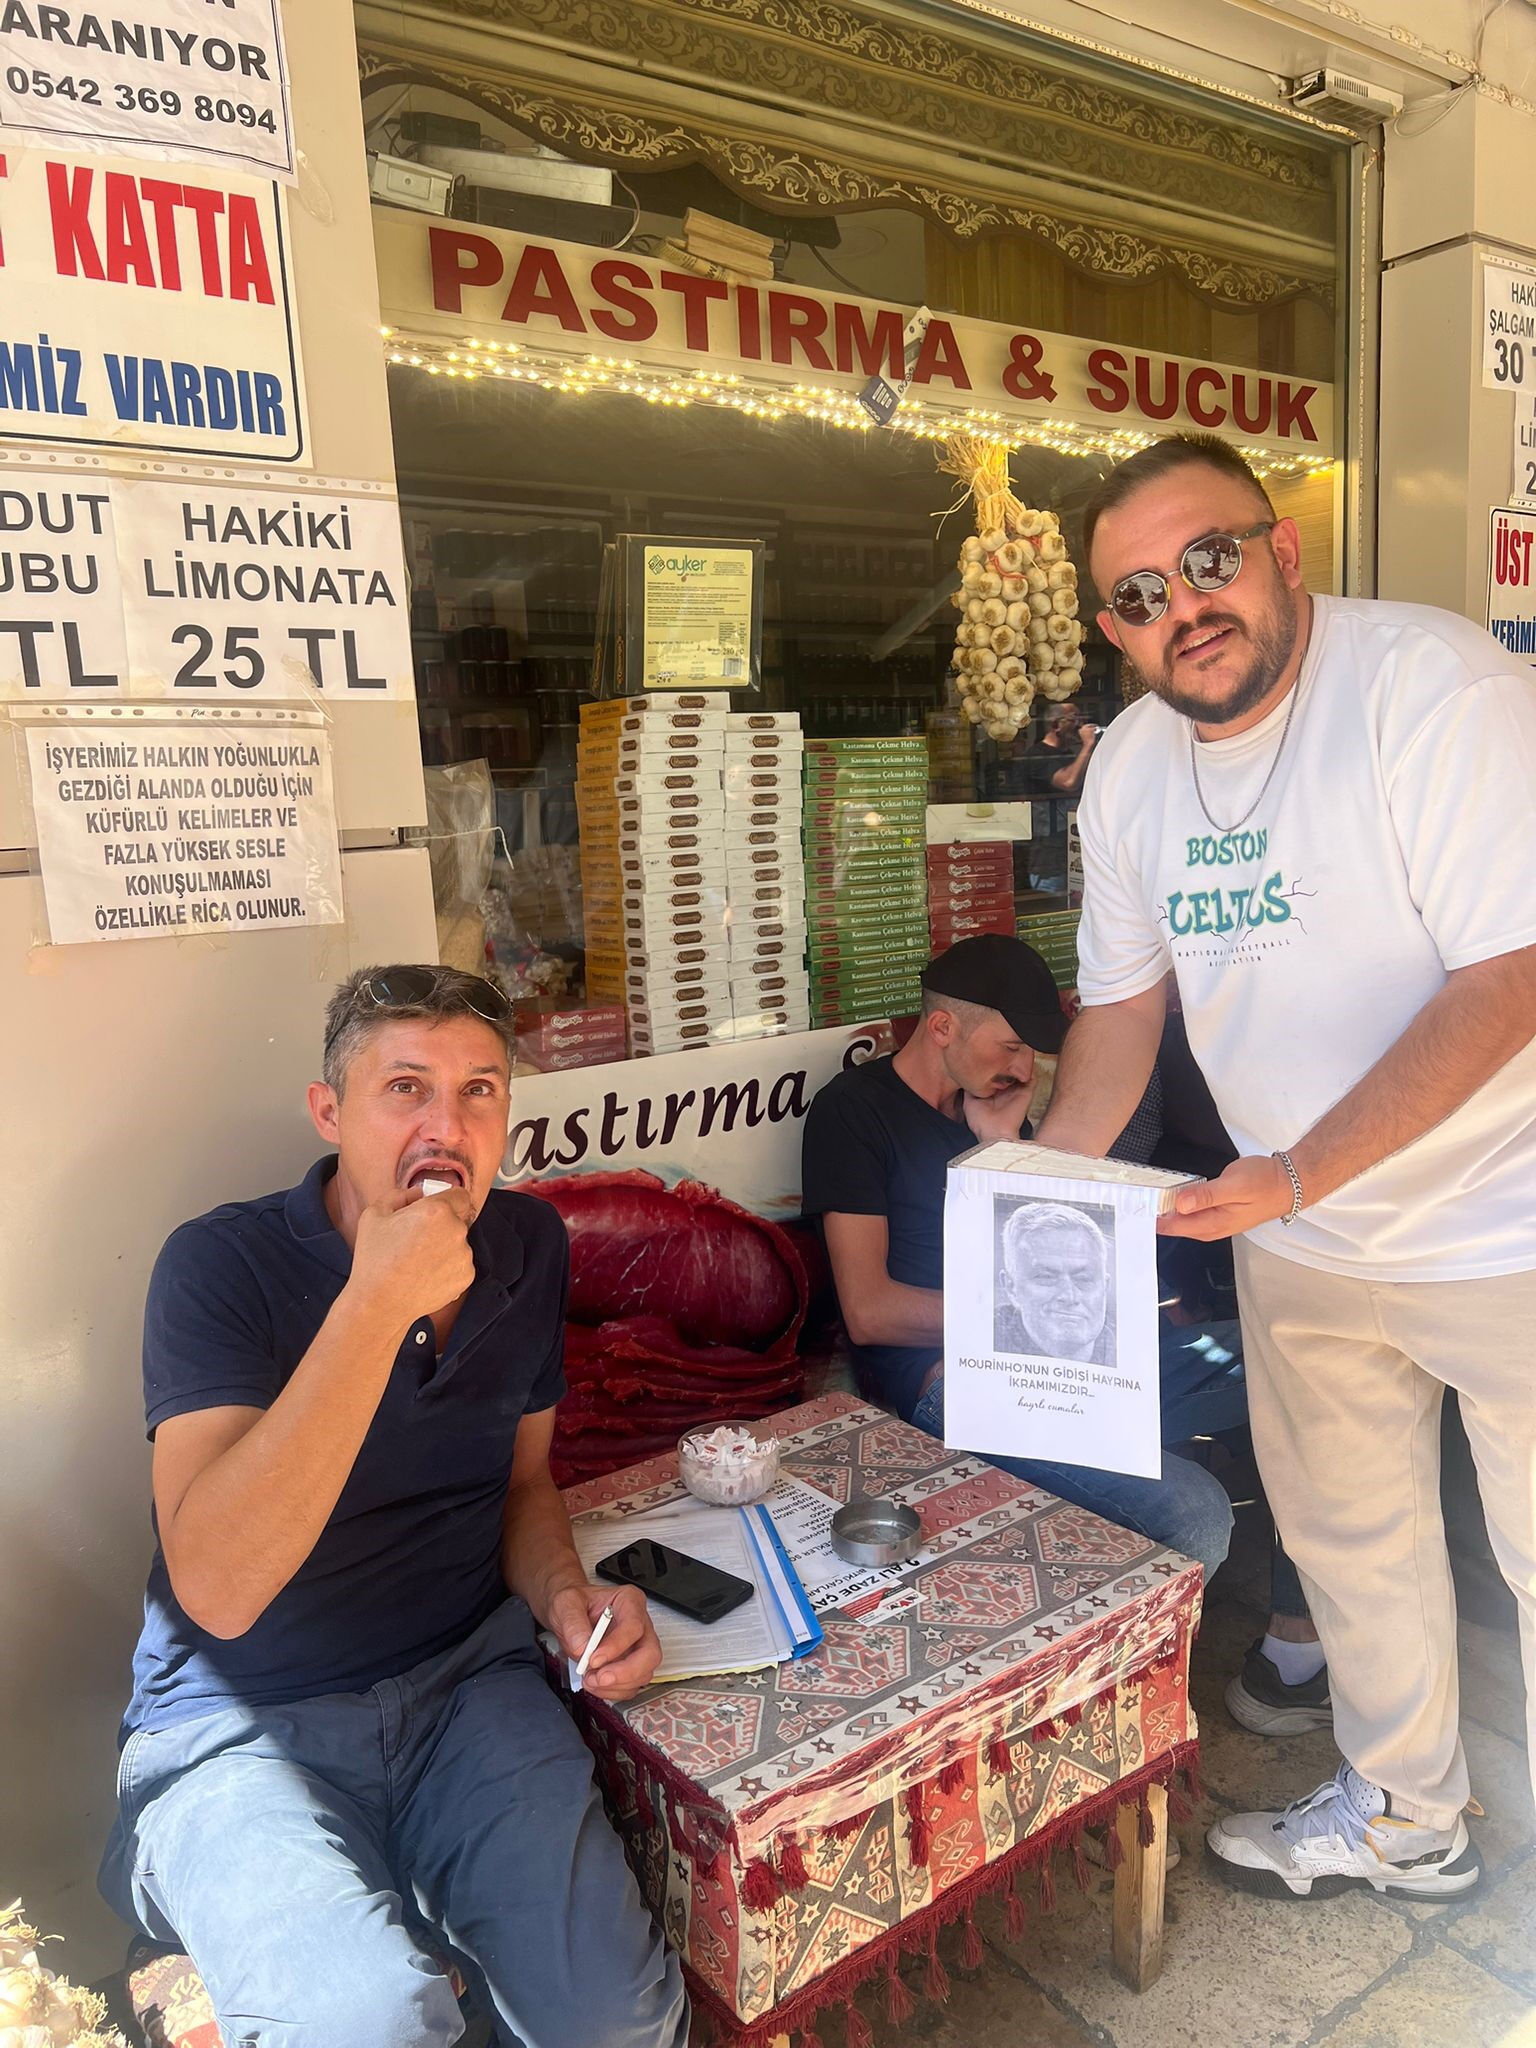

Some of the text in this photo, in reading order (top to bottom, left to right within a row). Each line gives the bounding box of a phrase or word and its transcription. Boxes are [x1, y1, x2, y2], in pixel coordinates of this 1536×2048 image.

[1, 0, 270, 81] ARANIYOR
[7, 66, 277, 134] 0542 369 8094
[45, 161, 276, 305] KATTA
[429, 227, 1318, 442] PASTIRMA & SUCUK
[1490, 309, 1534, 338] ŞALGAM
[1494, 338, 1524, 384] 30
[103, 353, 287, 437] VARDIR
[183, 501, 352, 550] HAKİKİ
[666, 554, 707, 576] ayker
[1495, 517, 1533, 586] ÜST
[144, 550, 396, 606] LİMONATA
[171, 624, 387, 689] 25 TL
[46, 741, 320, 773] İŞYERİMİZ HALKIN YOĞUNLUKLA
[58, 771, 313, 802] GEZDİĞİ ALANDA OLDUĞU İÇİN
[86, 804, 298, 834] KÜFÜRLÜ KELİMELER VE
[104, 837, 286, 865] FAZLA YÜKSEK SESLE
[1186, 828, 1267, 867] BOSTON
[125, 868, 271, 899] KONUŞULMAMASI
[94, 897, 306, 931] ÖZELLİKLE RİCA OLUNUR.
[506, 1070, 811, 1172] astırma
[958, 1357, 1142, 1392] MOURİNHO'NUN GİDİŞİ HAYRINA
[838, 1576, 880, 1597] ZADE
[878, 1563, 903, 1580] ALİ
